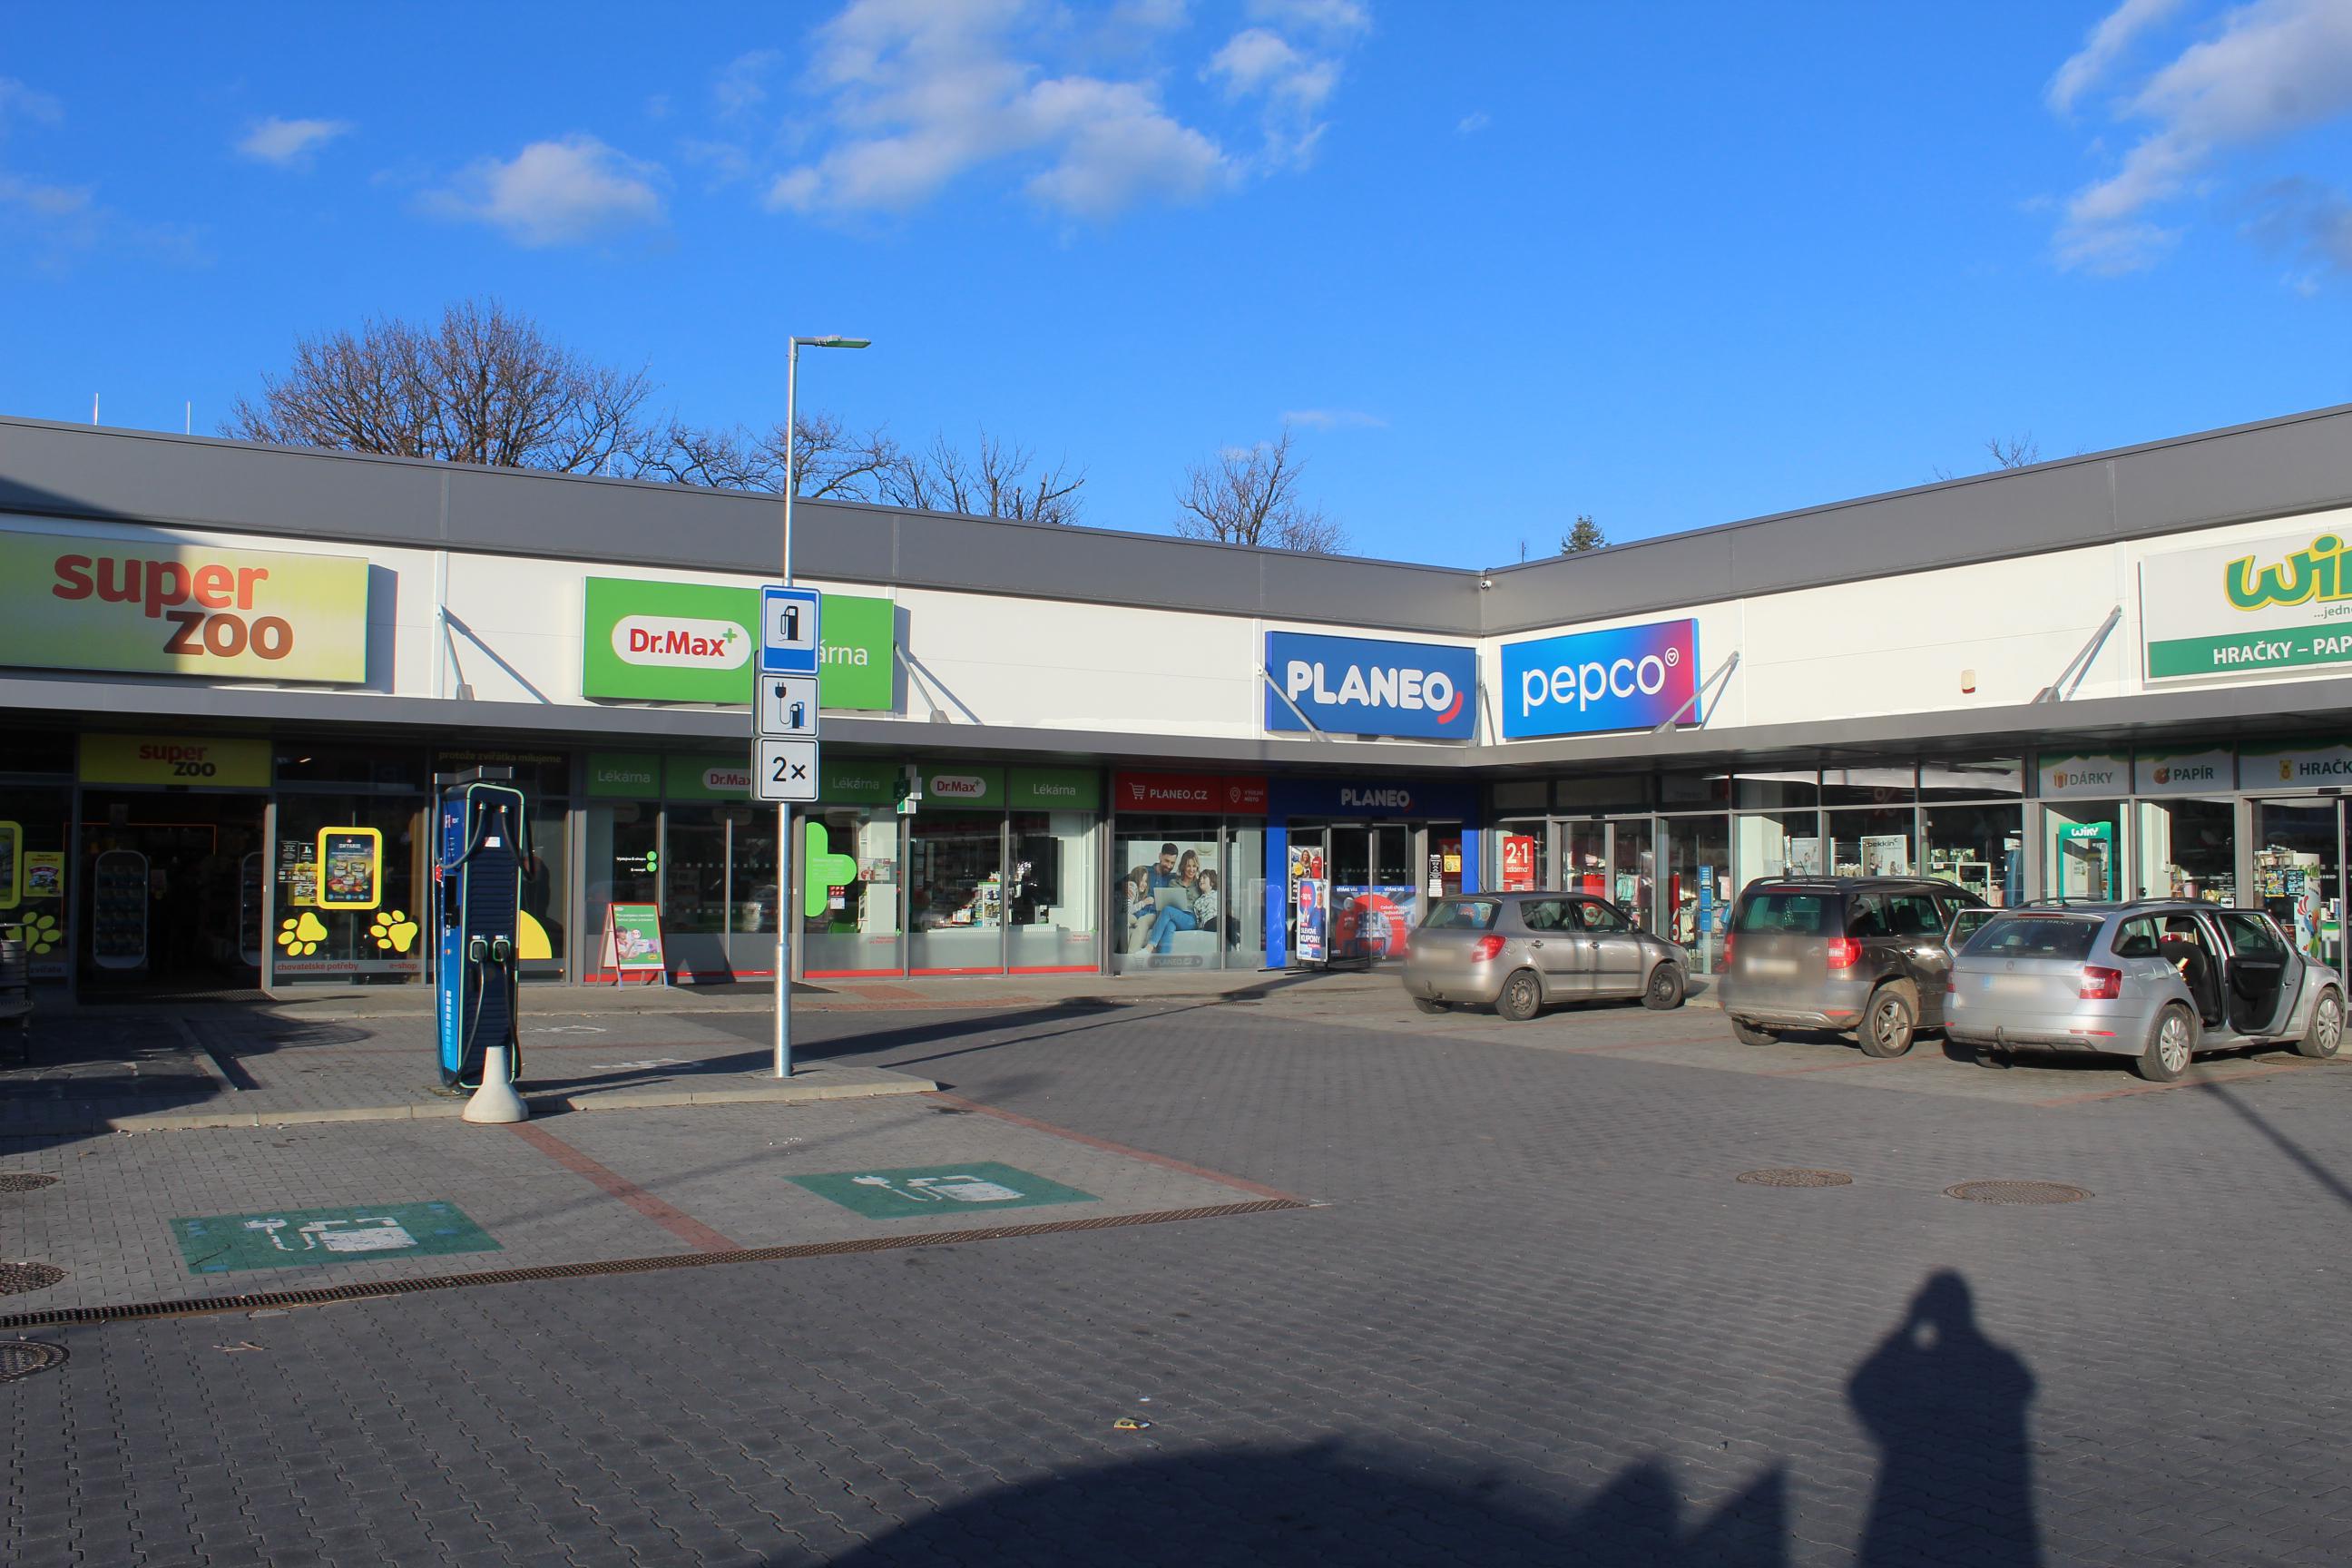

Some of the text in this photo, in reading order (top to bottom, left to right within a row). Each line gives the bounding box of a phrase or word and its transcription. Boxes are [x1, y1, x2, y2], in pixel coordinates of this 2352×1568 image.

[52, 554, 269, 619] super
[163, 611, 294, 661] zoo
[2213, 641, 2293, 665] HRAČKY
[1288, 660, 1454, 711] PLANEO
[1523, 654, 1666, 717] pepco
[139, 744, 209, 764] super
[438, 750, 475, 761] protože
[518, 753, 563, 765] milujeme
[173, 762, 216, 777] zoo
[598, 769, 651, 783] Lékárna
[2173, 765, 2214, 780] PAPÍR
[833, 777, 879, 790] Lékárna
[2070, 771, 2112, 786] DÁRKY
[1034, 783, 1076, 796] Lékárna
[1150, 789, 1208, 800] PLANEO.CZ
[1341, 789, 1410, 808] PLANEO
[1506, 842, 1528, 864] 2+1
[277, 962, 417, 972] chovatelské potřeby e-shop
